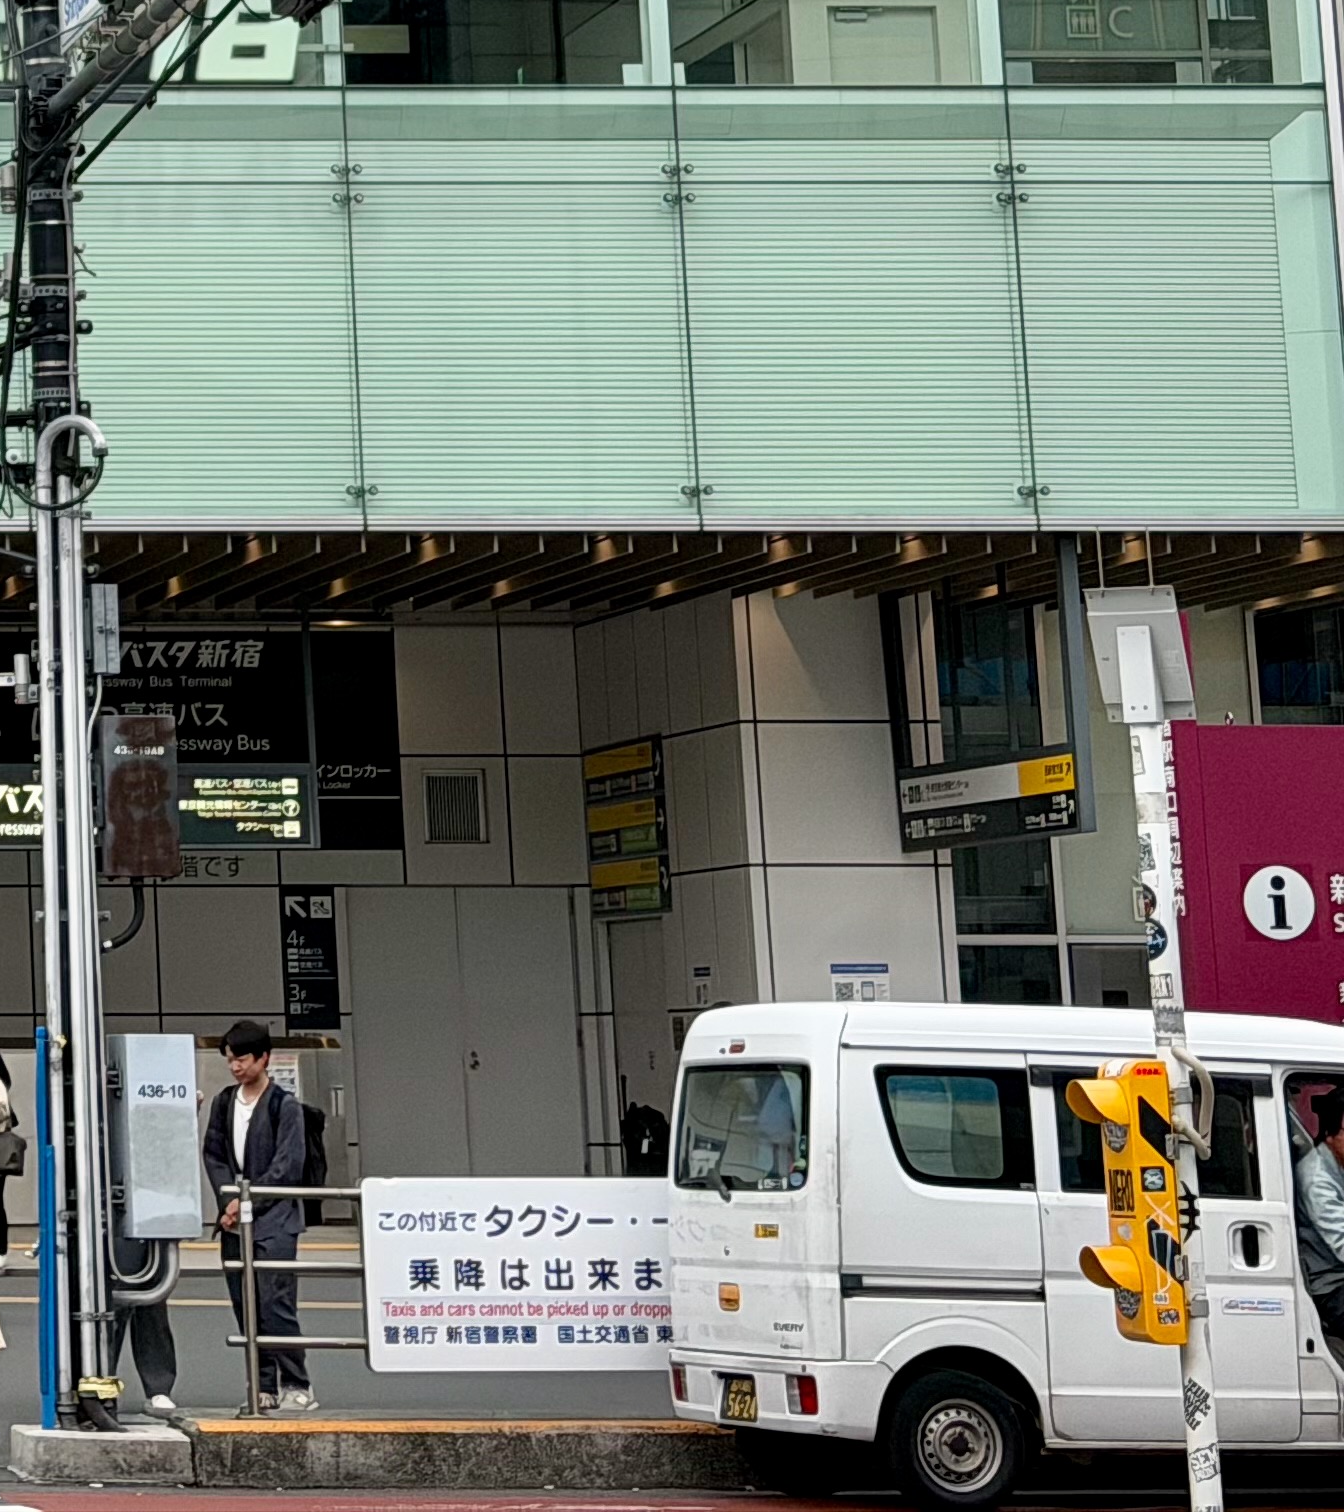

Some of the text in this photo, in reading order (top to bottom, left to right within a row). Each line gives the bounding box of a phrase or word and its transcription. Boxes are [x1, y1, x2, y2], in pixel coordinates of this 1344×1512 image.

[120, 639, 265, 668] バスタ新宿
[149, 675, 174, 688] Bus
[179, 675, 233, 688] Terminal
[237, 734, 271, 751] Bus
[316, 763, 392, 778] インロッカー
[138, 1084, 187, 1099] 436-10
[409, 1257, 664, 1292] 乗降は出来ま
[383, 1300, 672, 1320] Taxis and cars cannot be picked up or dropp
[558, 1325, 649, 1345] 国土交通省
